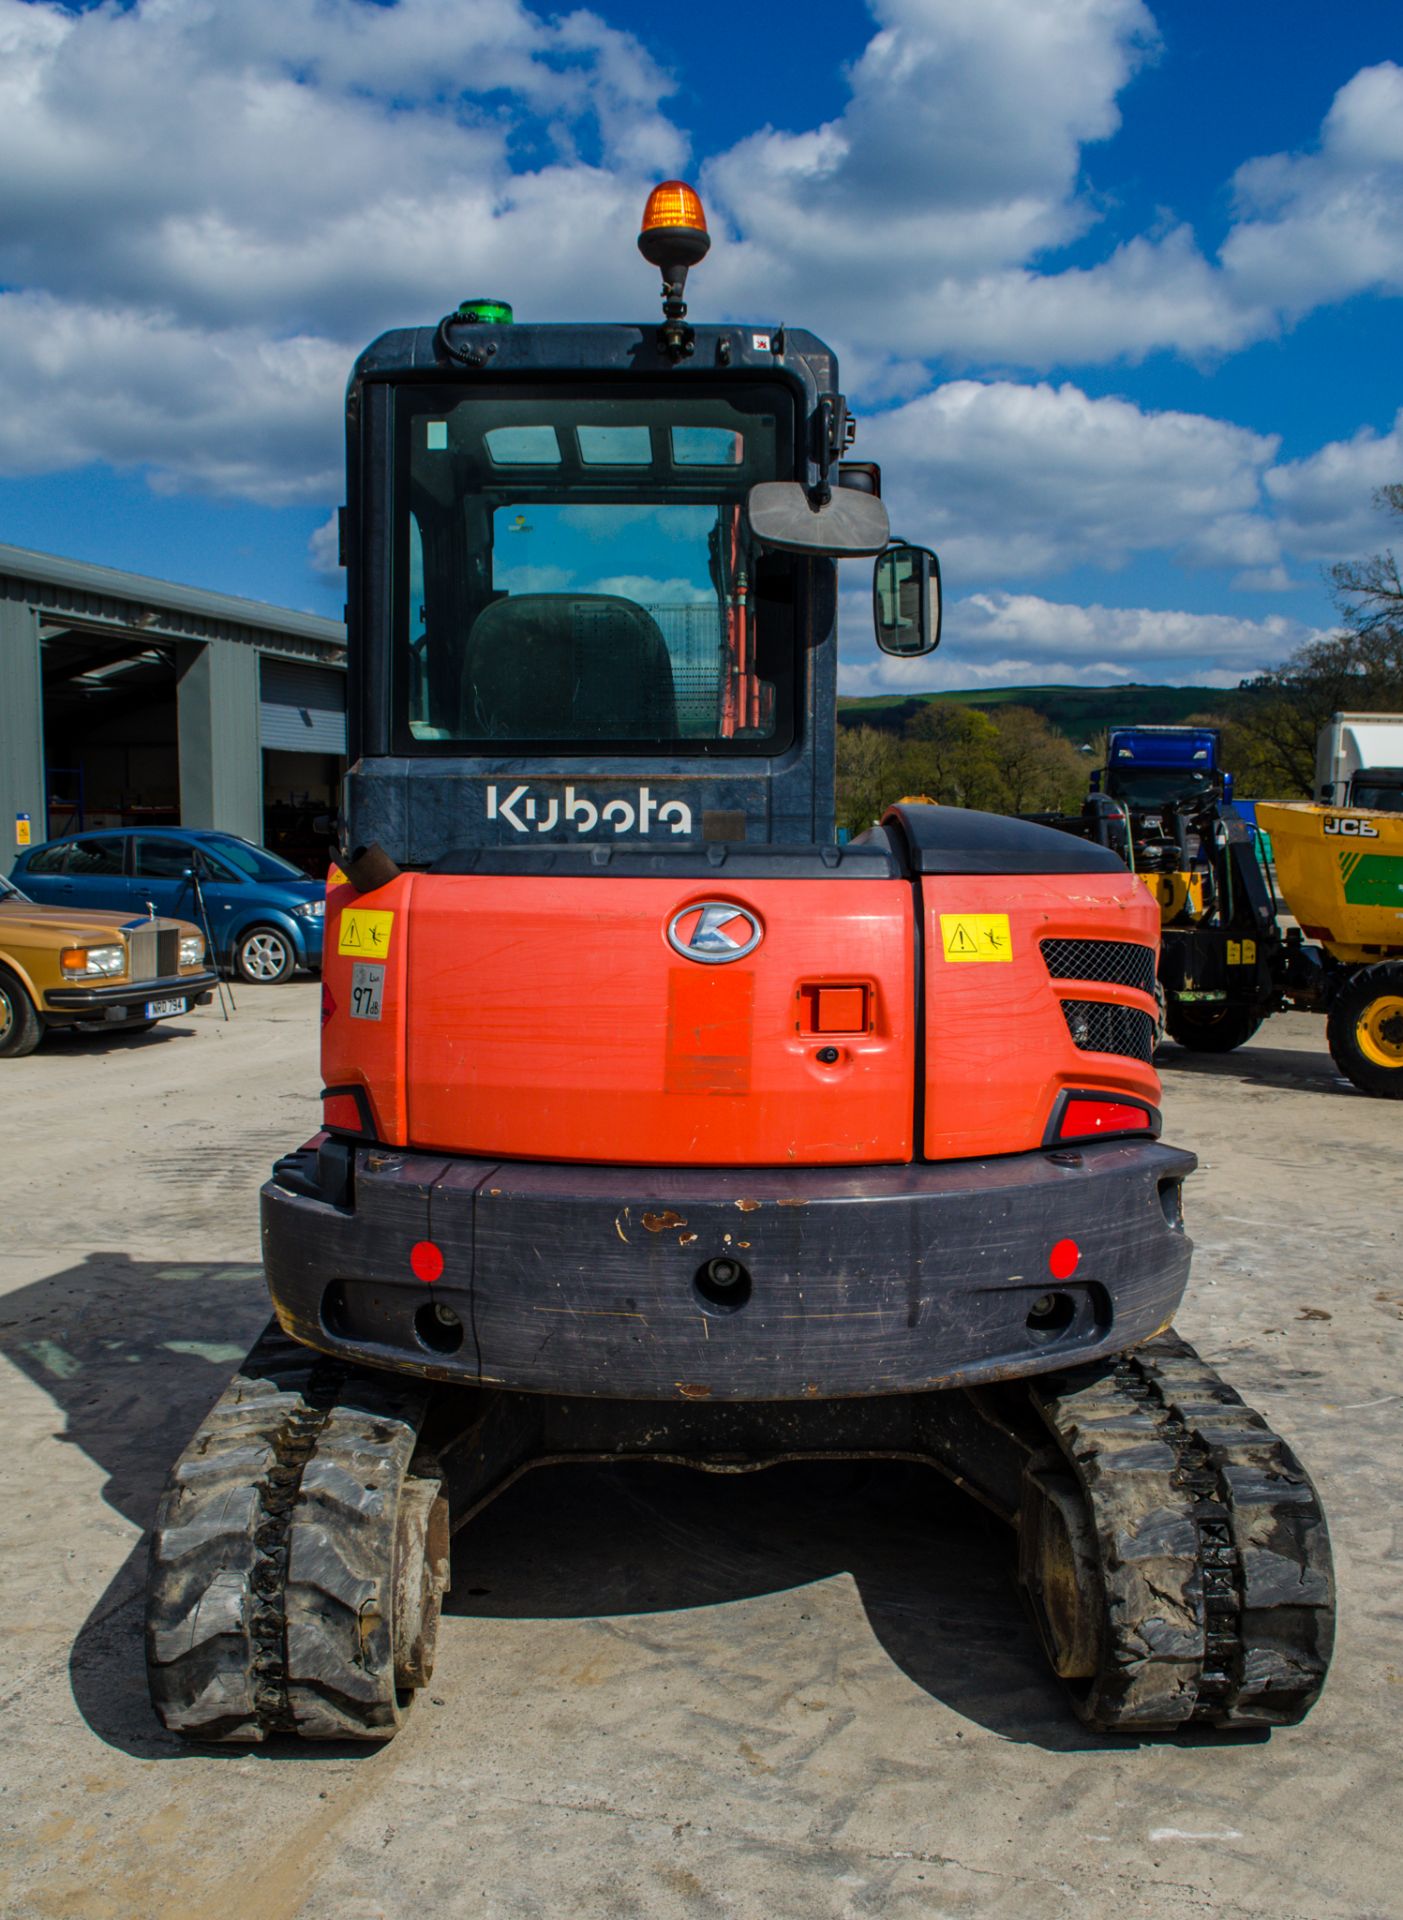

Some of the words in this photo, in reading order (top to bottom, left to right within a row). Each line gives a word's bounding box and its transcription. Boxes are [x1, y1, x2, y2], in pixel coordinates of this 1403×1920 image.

[486, 785, 692, 834] Kubota
[1324, 818, 1379, 838] JCB
[167, 998, 182, 1012] 794
[353, 987, 373, 1014] 97
